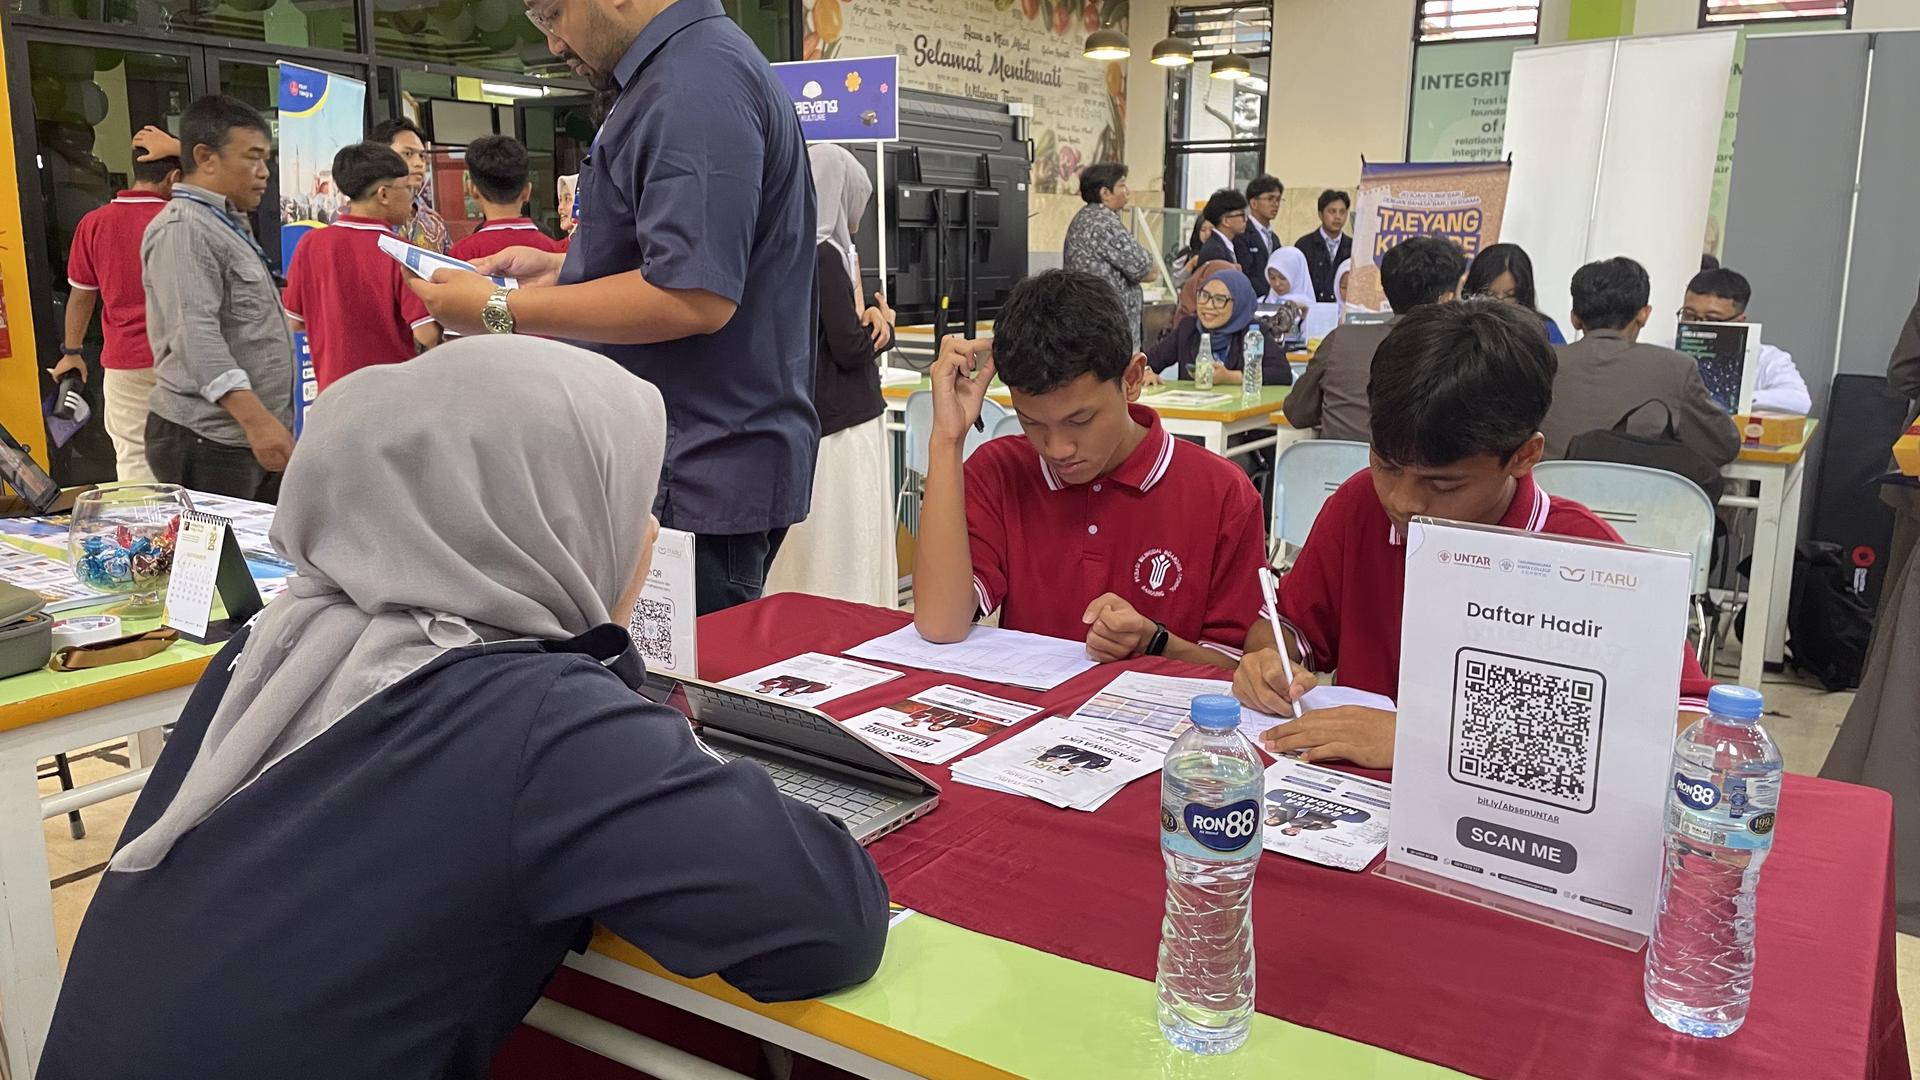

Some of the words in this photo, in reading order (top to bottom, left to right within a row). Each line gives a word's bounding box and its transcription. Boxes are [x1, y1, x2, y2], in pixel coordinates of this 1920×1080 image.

[914, 34, 983, 74] Selamat
[987, 52, 1062, 88] Menikmati
[1421, 70, 1510, 90] INTEGRIT
[1472, 96, 1497, 105] Trust
[1471, 108, 1506, 116] founda
[1481, 119, 1499, 133] of
[1455, 136, 1504, 145] relationsh
[1452, 147, 1492, 157] integrity
[1380, 209, 1480, 233] TAEYANG
[1454, 552, 1491, 566] UNTAR
[1591, 569, 1637, 588] ITARU
[1467, 601, 1535, 627] Daftar
[1540, 613, 1603, 638] Hadir
[859, 724, 896, 737] SORE
[1084, 741, 1142, 764] BEASISWA
[1676, 779, 1715, 806] RON88
[1283, 791, 1359, 815] MANDARIN
[1285, 798, 1343, 817] BAHASA
[1477, 796, 1560, 824] bit.ly/AbsenUNTAR
[1192, 808, 1255, 838] RON88
[1470, 826, 1526, 854] SCAN
[1530, 842, 1562, 864] ME
